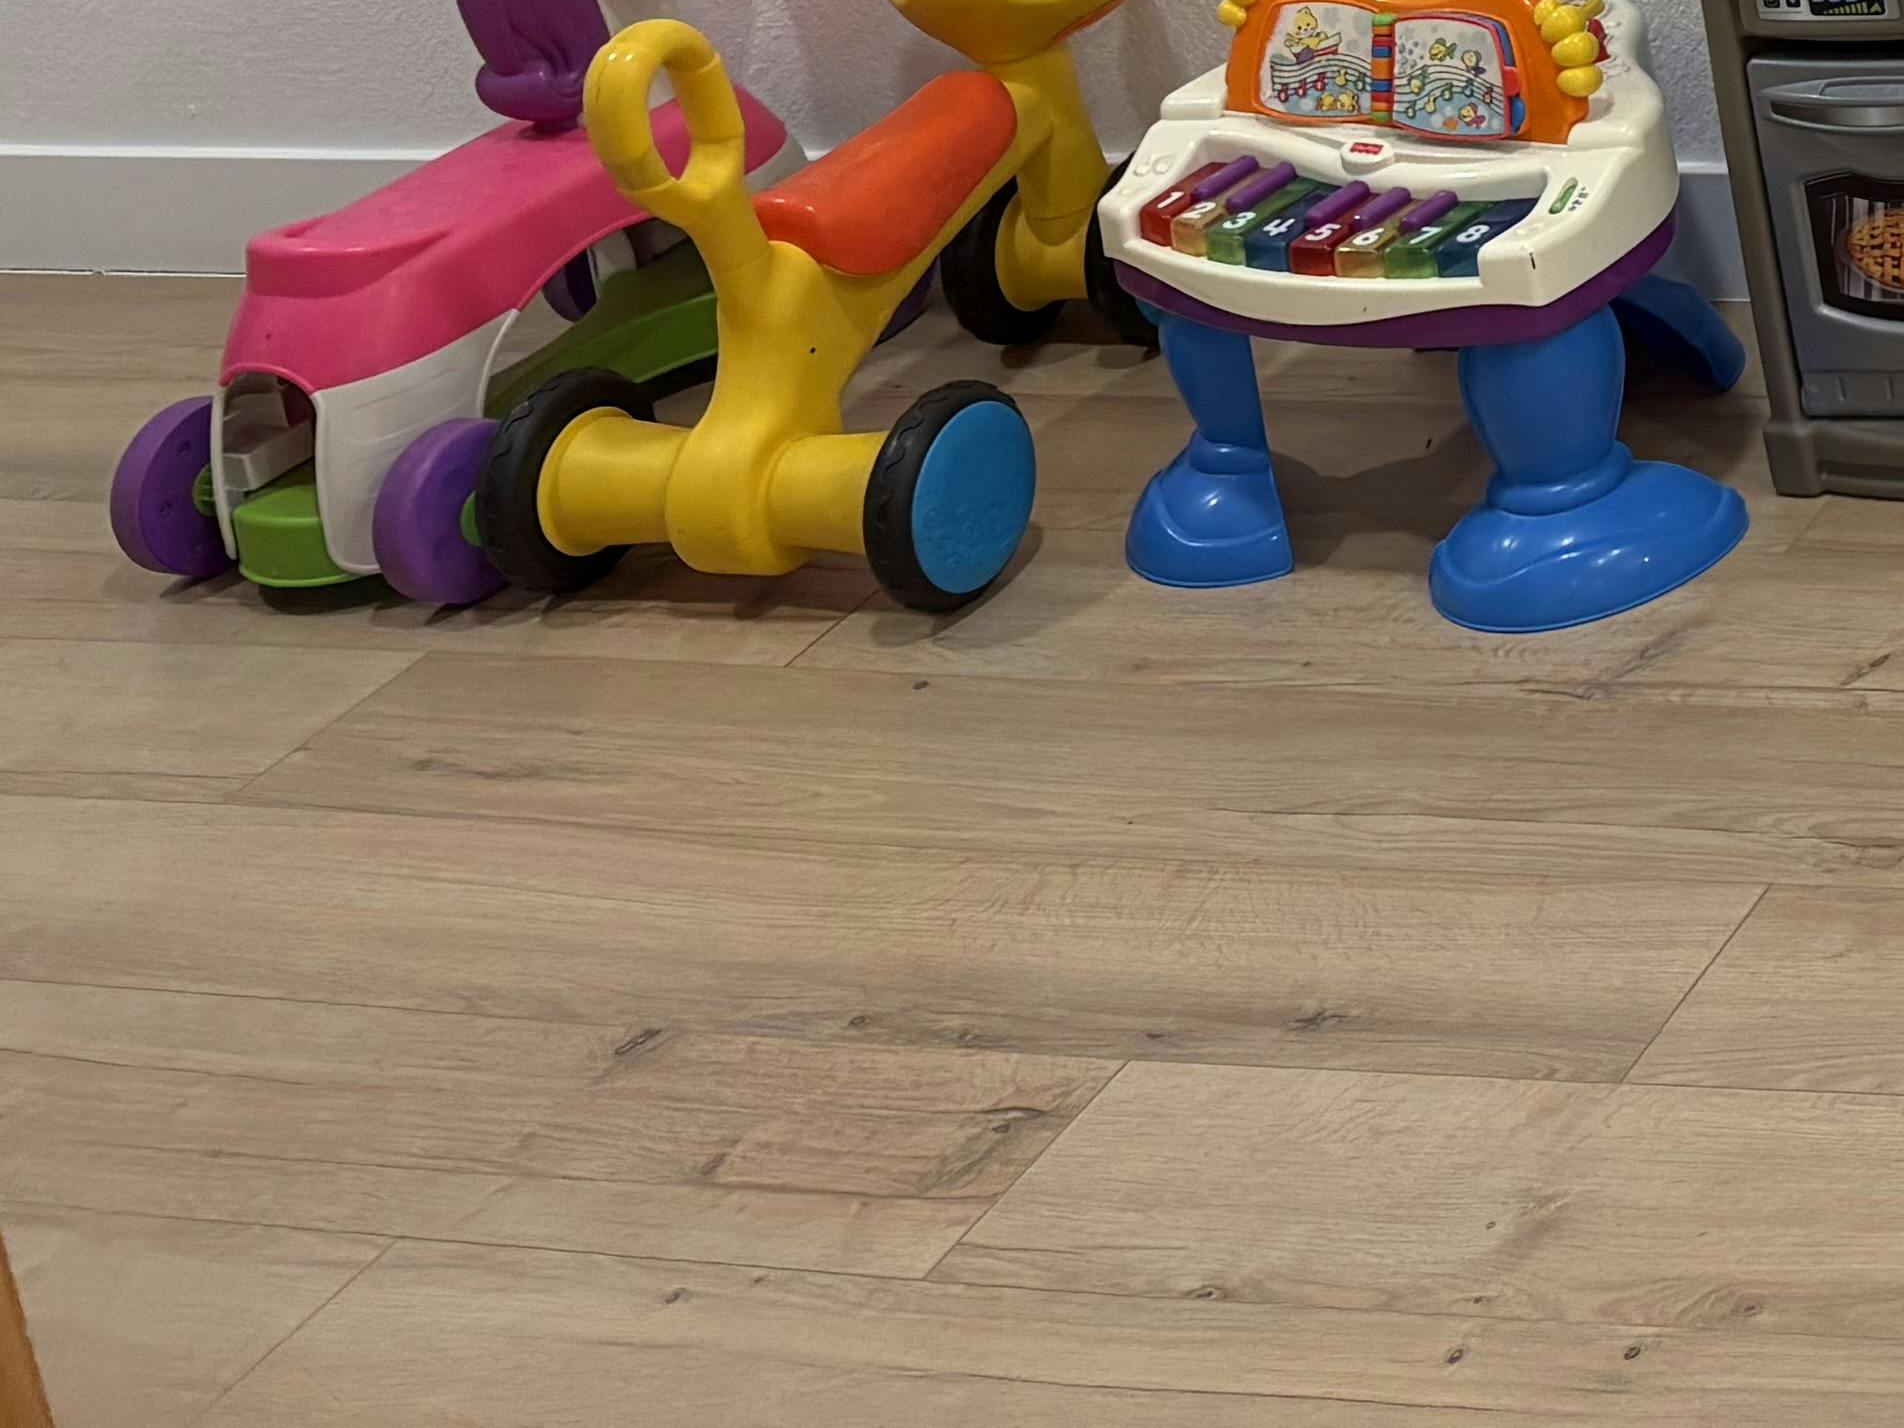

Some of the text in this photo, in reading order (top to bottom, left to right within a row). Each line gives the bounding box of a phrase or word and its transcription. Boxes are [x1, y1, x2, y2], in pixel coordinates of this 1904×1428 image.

[1157, 192, 1490, 245] 1 2 3 4 5 6 7 8
